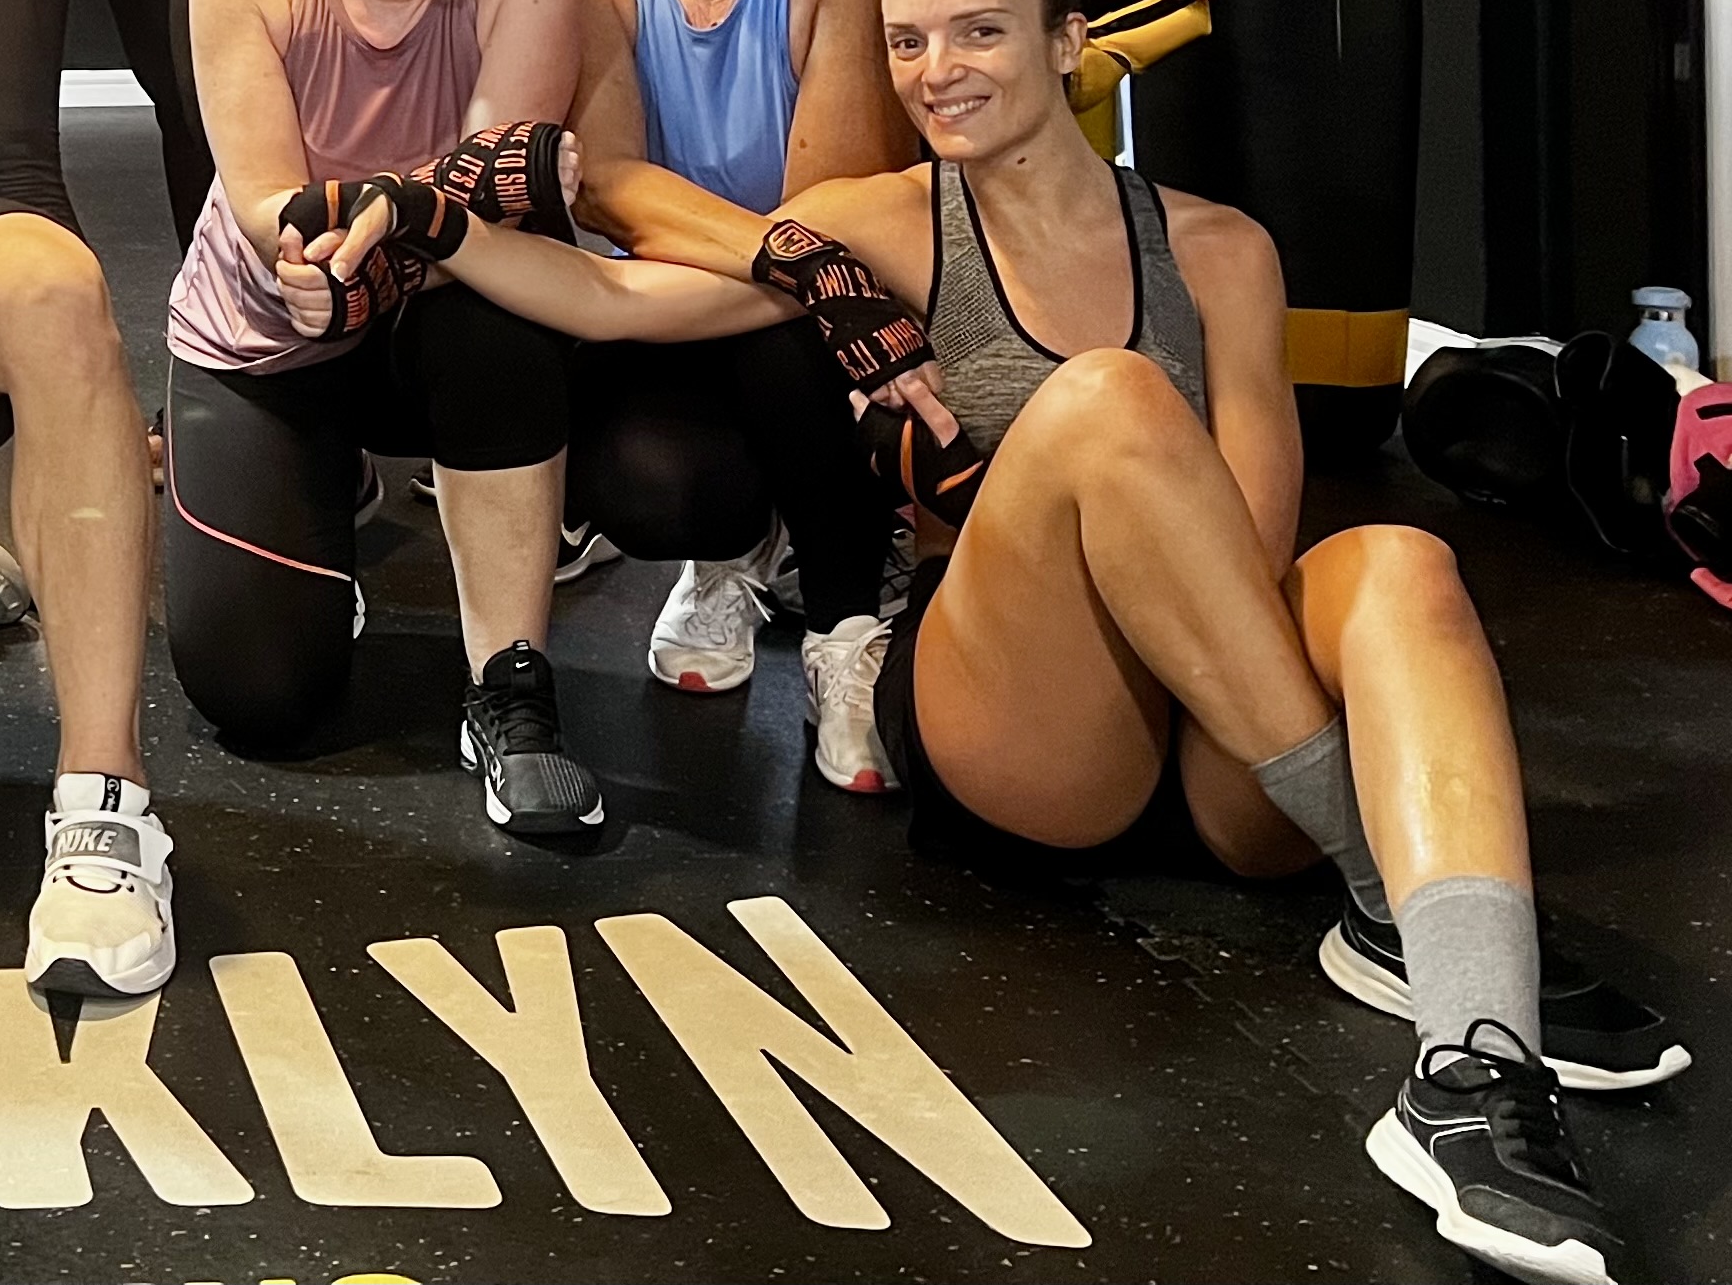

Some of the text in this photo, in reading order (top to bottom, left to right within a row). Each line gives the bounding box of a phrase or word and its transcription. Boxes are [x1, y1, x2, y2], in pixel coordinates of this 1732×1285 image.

[448, 153, 485, 189] IT'S
[837, 339, 880, 381] IT'S
[55, 827, 118, 857] NIKE
